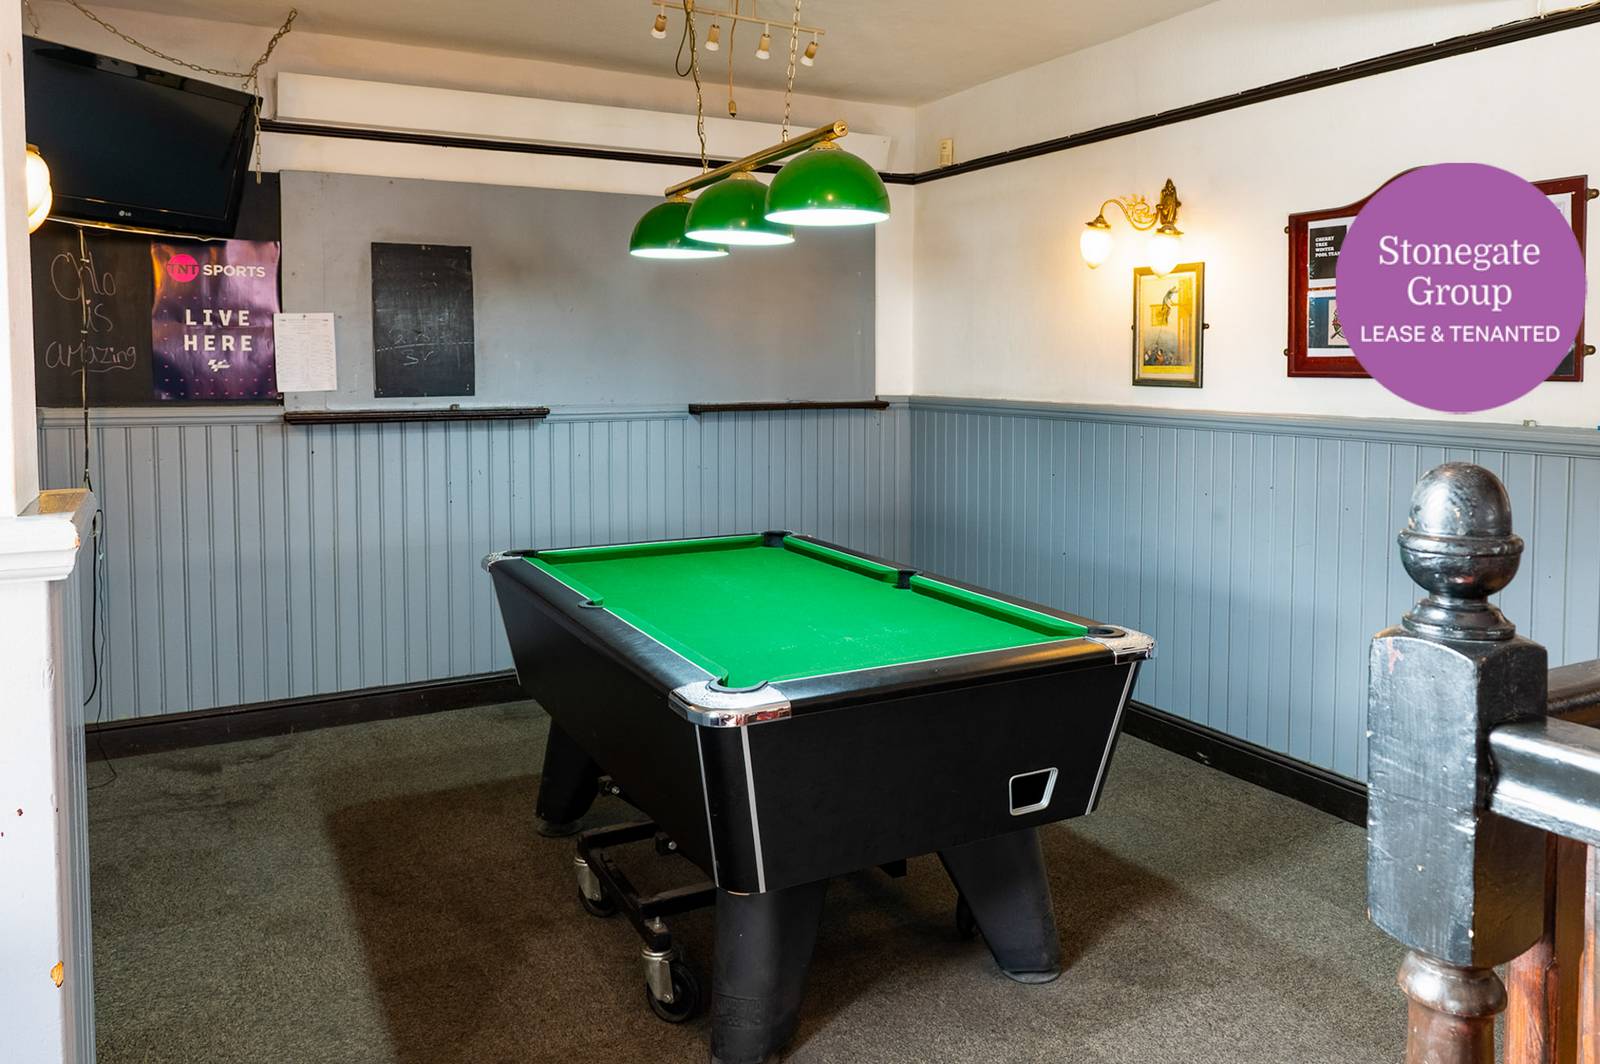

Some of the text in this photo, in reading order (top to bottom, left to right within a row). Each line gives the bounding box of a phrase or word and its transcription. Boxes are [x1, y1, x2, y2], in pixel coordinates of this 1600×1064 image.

[167, 263, 266, 277] TNT SPORTS
[86, 299, 113, 332] is
[185, 308, 250, 326] LIVE
[184, 334, 253, 351] HERE
